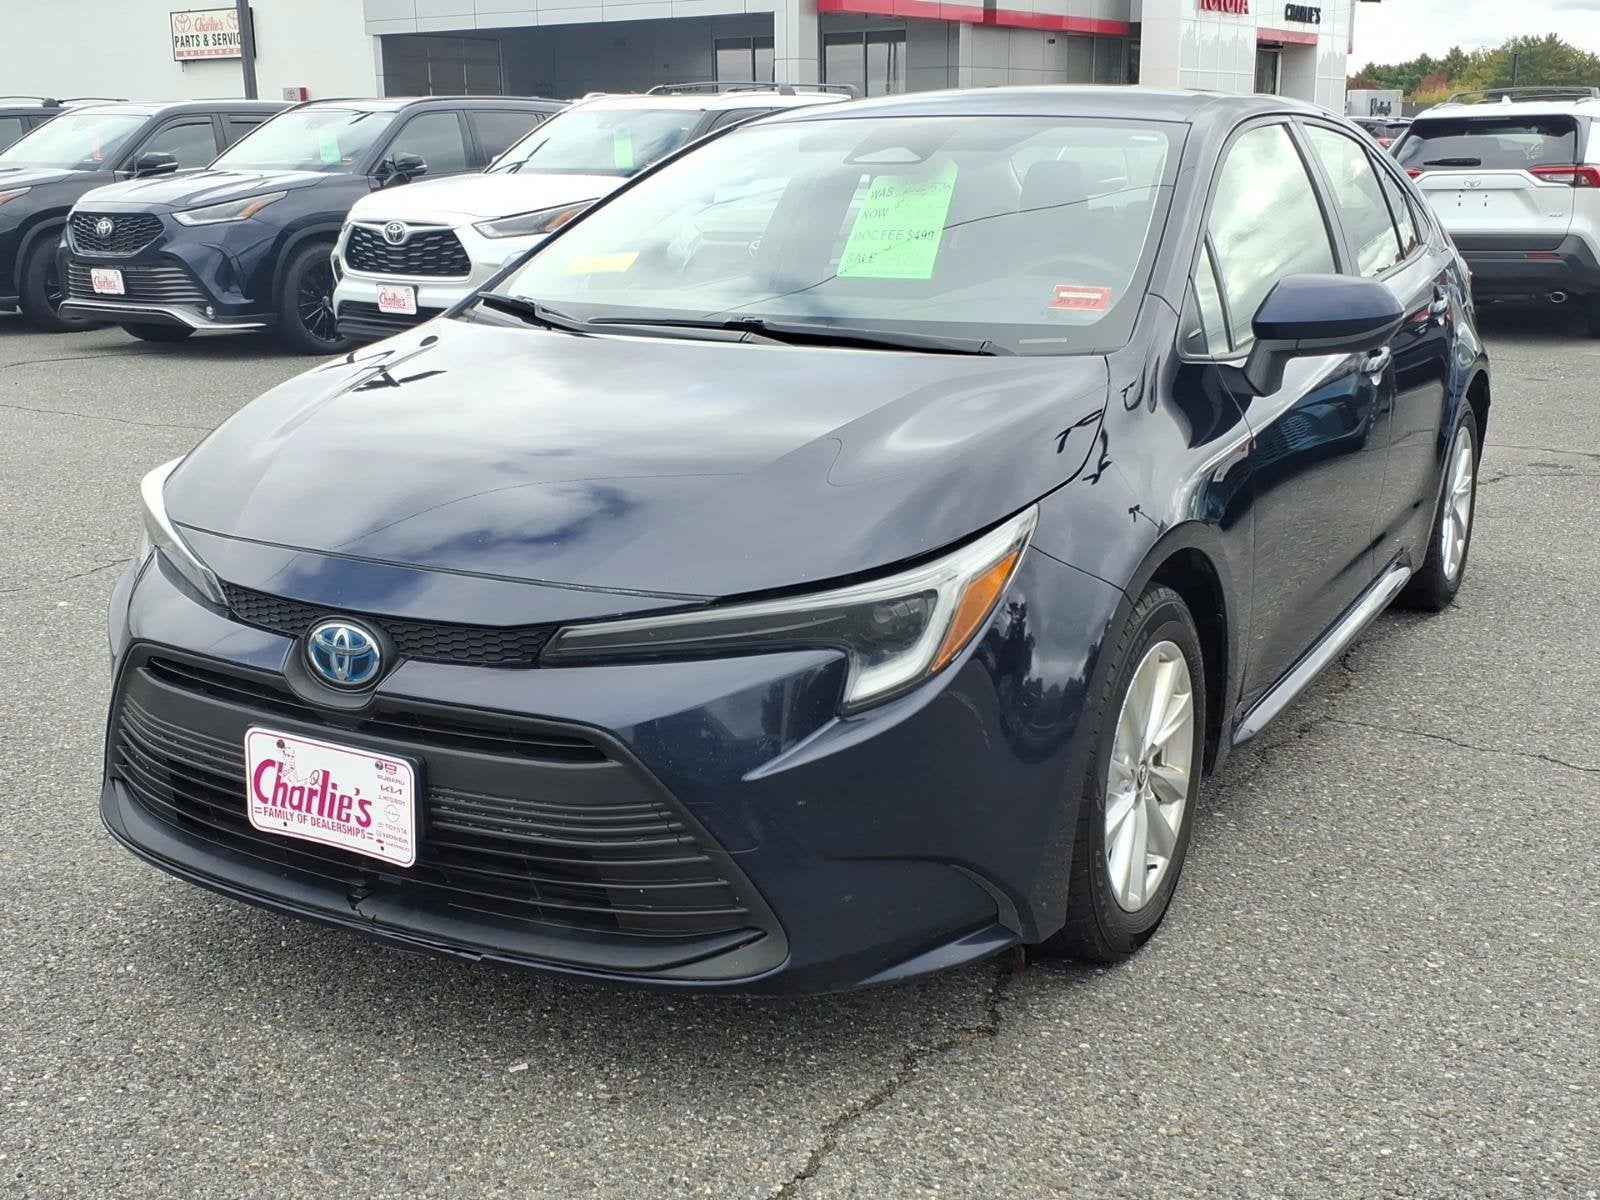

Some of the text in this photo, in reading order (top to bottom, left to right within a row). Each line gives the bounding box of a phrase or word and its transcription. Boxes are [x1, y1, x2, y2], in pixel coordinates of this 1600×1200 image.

[175, 32, 241, 48] PARTS & SERVIC
[871, 186, 895, 200] WAS
[862, 208, 889, 219] NOW
[853, 228, 935, 242] DOC FEE $499
[253, 758, 373, 828] Charlie's
[263, 806, 366, 840] FAMILY OF DEALERSHIPS
[385, 823, 408, 835] TOYOTA
